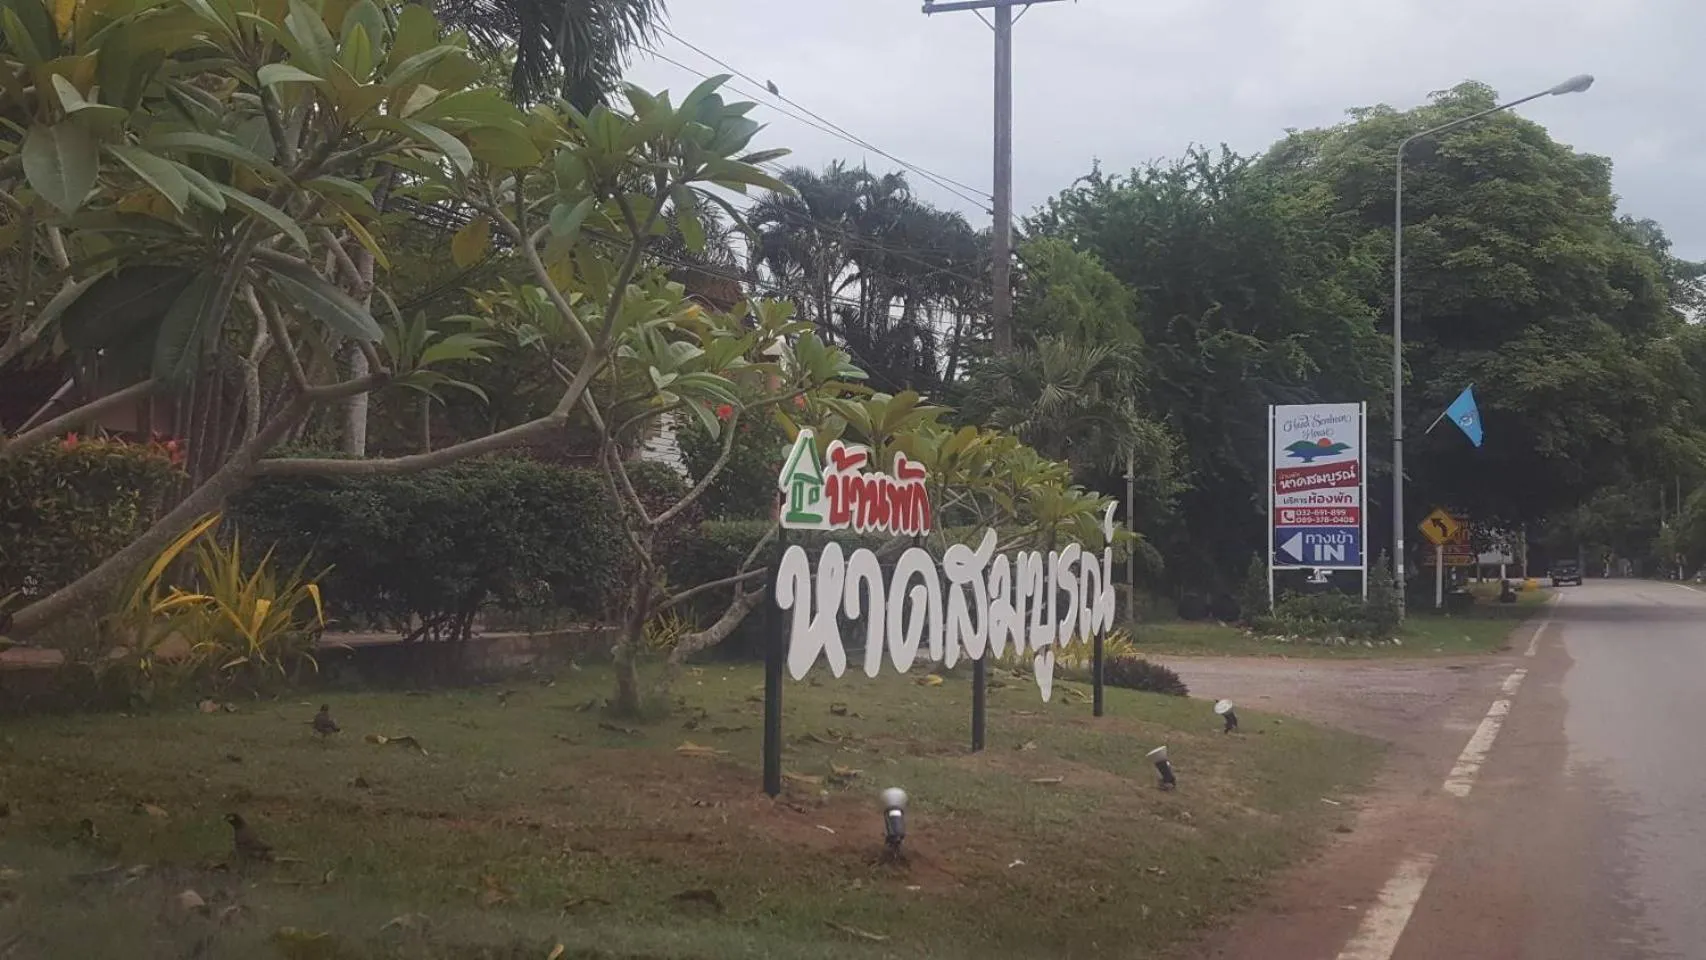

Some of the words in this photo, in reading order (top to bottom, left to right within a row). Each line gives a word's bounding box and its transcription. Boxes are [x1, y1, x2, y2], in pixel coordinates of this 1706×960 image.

[1279, 465, 1356, 488] หาดสมบูรณ์
[823, 440, 932, 537] บ้านพัก
[1305, 529, 1354, 543] ทางเข้า
[1314, 544, 1345, 561] IN
[775, 500, 1119, 703] หาดสมบูรณ์
